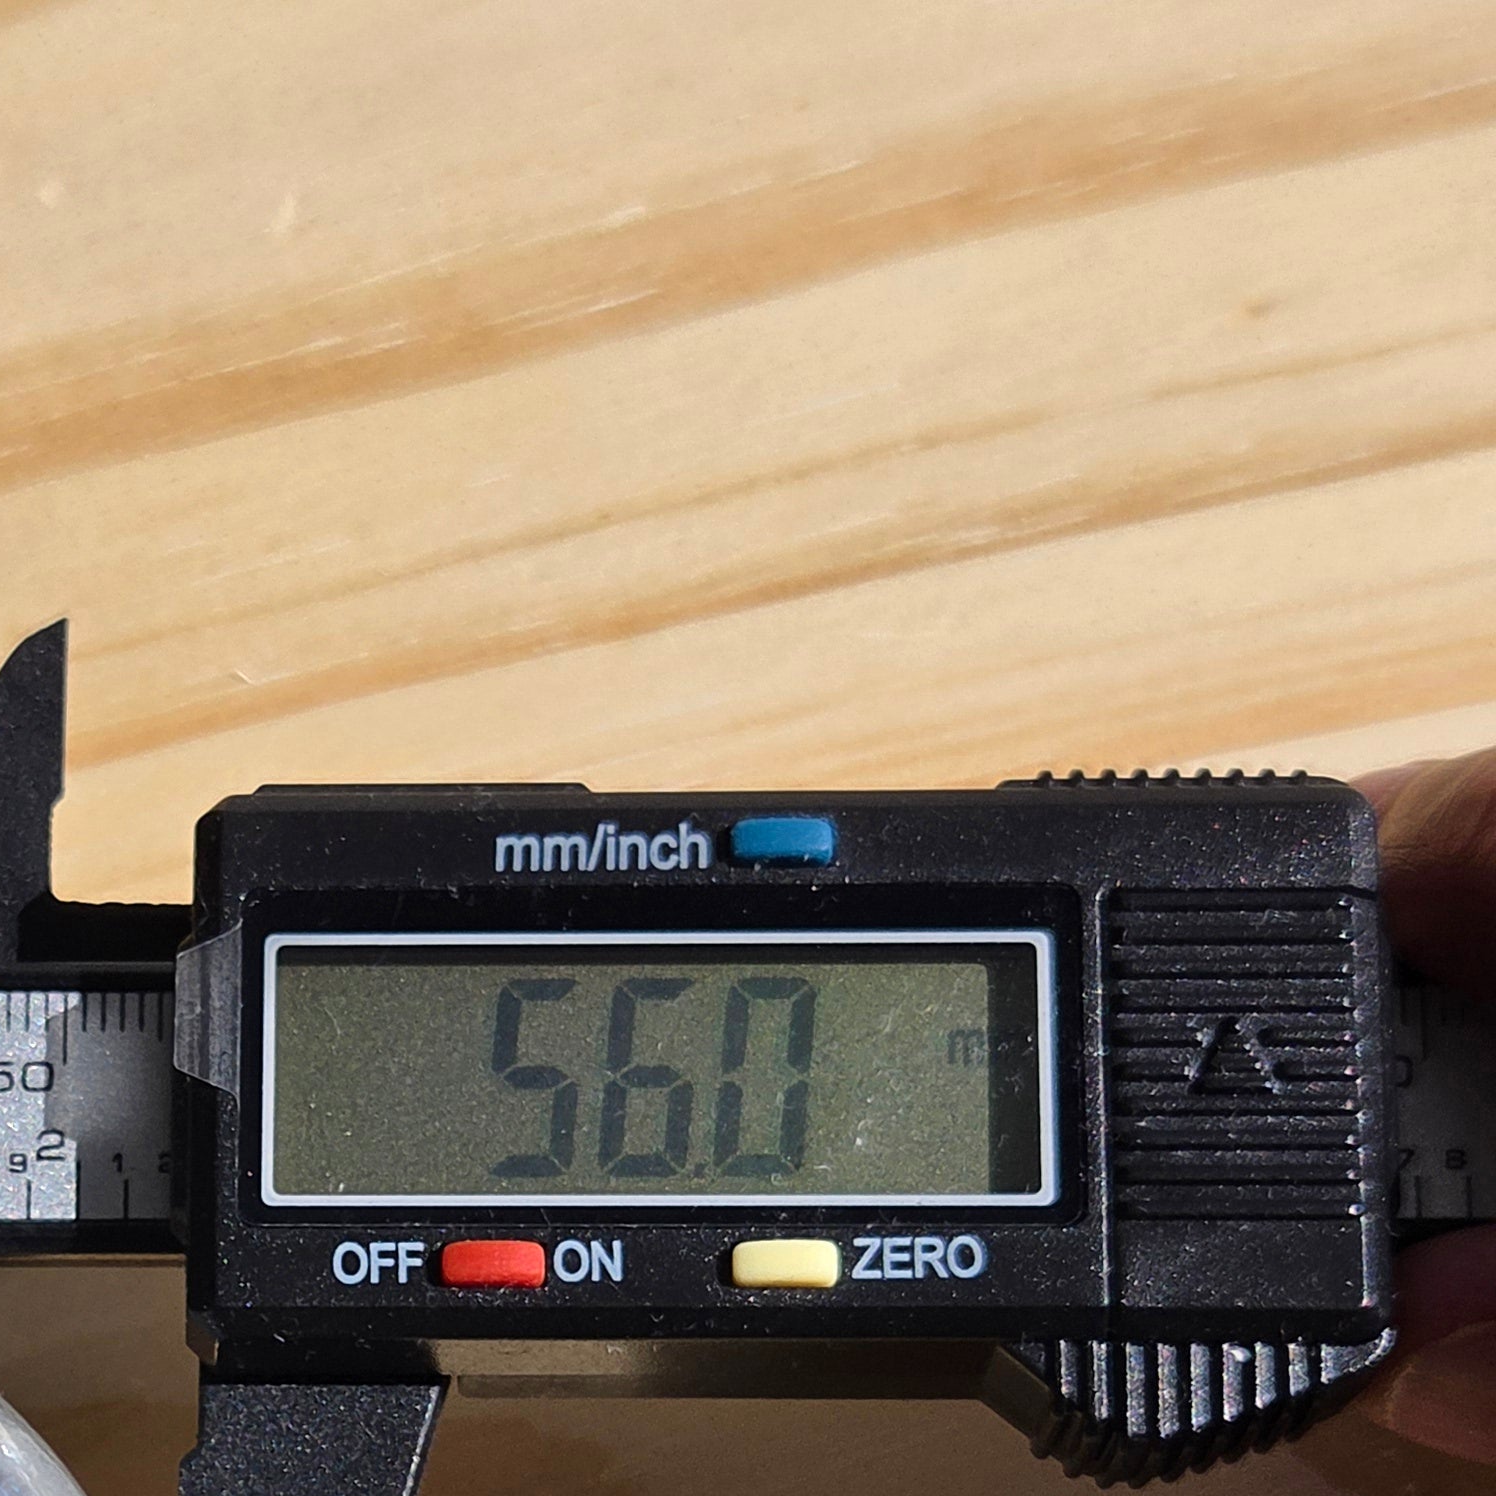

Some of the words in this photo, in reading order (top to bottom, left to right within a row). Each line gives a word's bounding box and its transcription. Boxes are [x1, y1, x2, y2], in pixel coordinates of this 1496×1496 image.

[495, 822, 710, 872] mm/inch
[489, 976, 818, 1178] 56.0
[9, 1153, 28, 1174] 9
[36, 1130, 65, 1161] 2
[113, 1153, 123, 1173] 1
[332, 1241, 425, 1284] OFF
[553, 1240, 624, 1282] ON
[851, 1235, 986, 1280] ZERO
